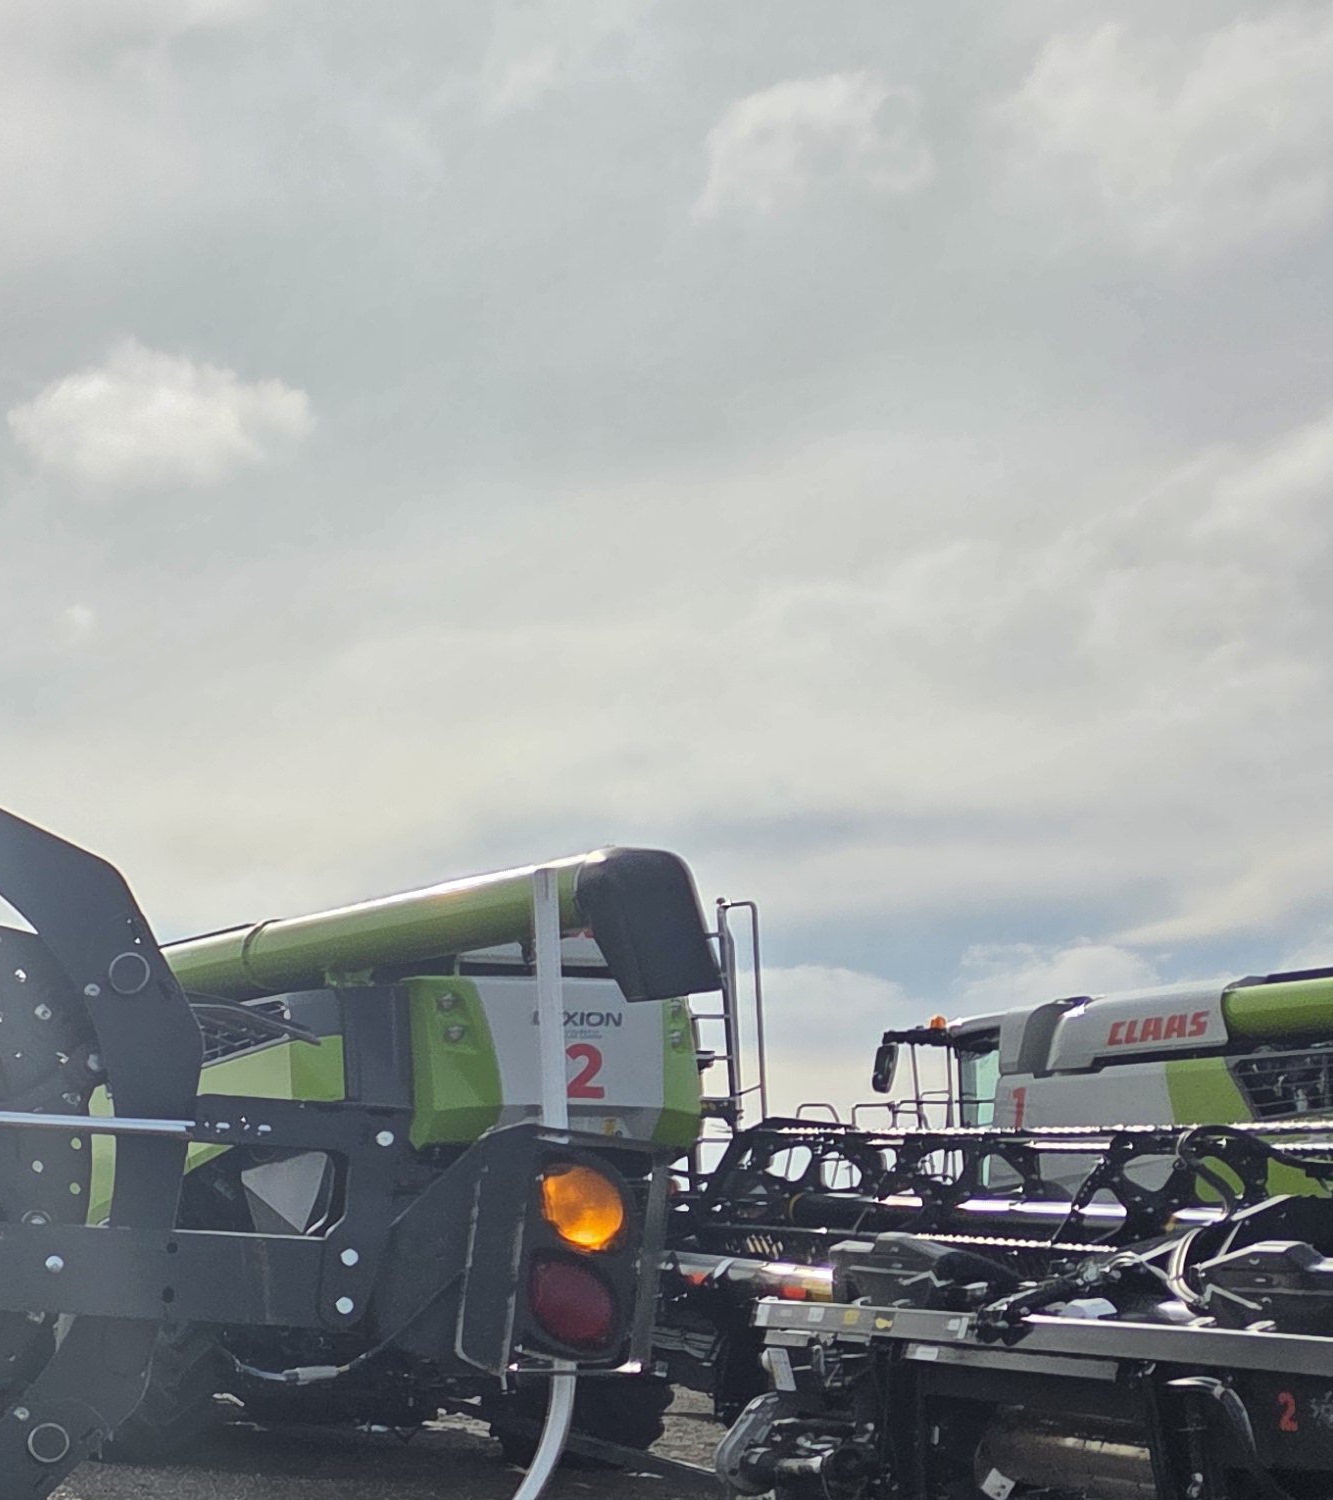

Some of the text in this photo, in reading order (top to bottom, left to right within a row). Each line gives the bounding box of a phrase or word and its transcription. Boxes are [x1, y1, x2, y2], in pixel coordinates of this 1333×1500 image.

[532, 1010, 622, 1027] XION
[1107, 1011, 1209, 1046] CLAAS
[565, 1043, 605, 1099] 2
[1013, 1087, 1026, 1128] 1
[1278, 1392, 1299, 1432] 2
